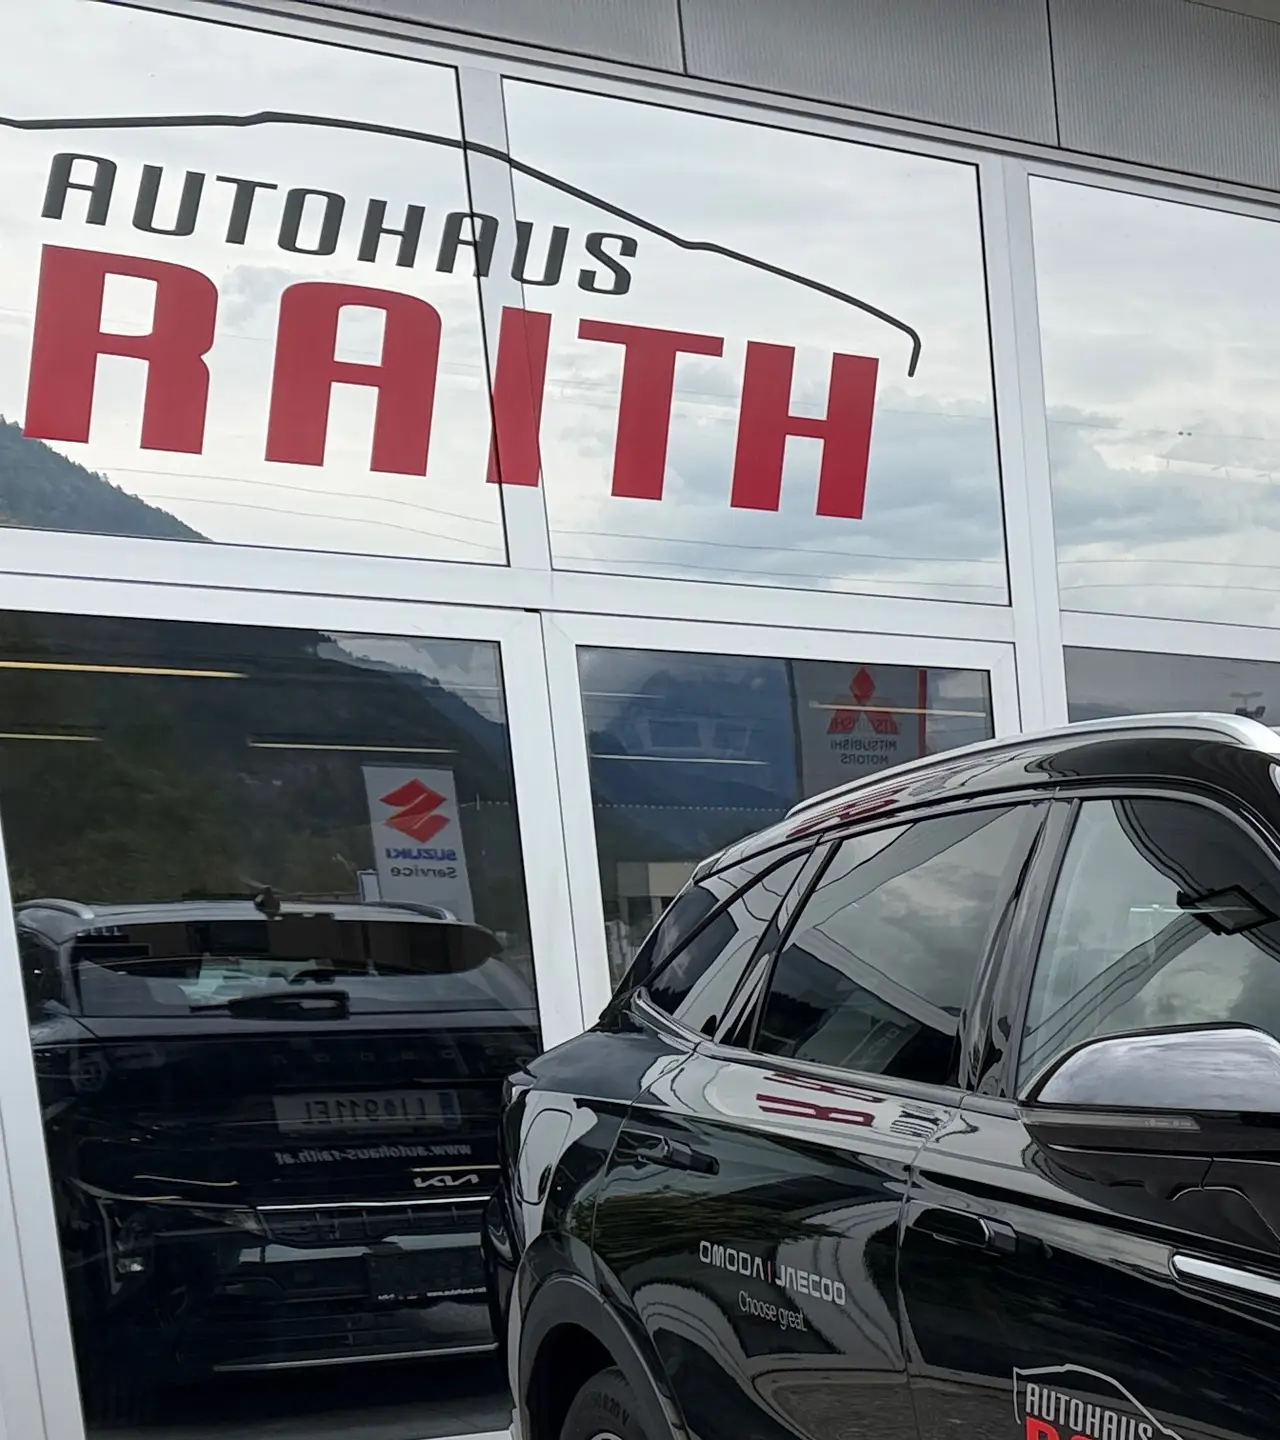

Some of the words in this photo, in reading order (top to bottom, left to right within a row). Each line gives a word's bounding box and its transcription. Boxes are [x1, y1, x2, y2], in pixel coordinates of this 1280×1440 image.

[41, 152, 638, 296] AUTOHAUS
[22, 243, 880, 520] RAITH
[698, 1240, 765, 1281] OMODA
[774, 1264, 847, 1306] JAECOO
[738, 1290, 777, 1323] Choose
